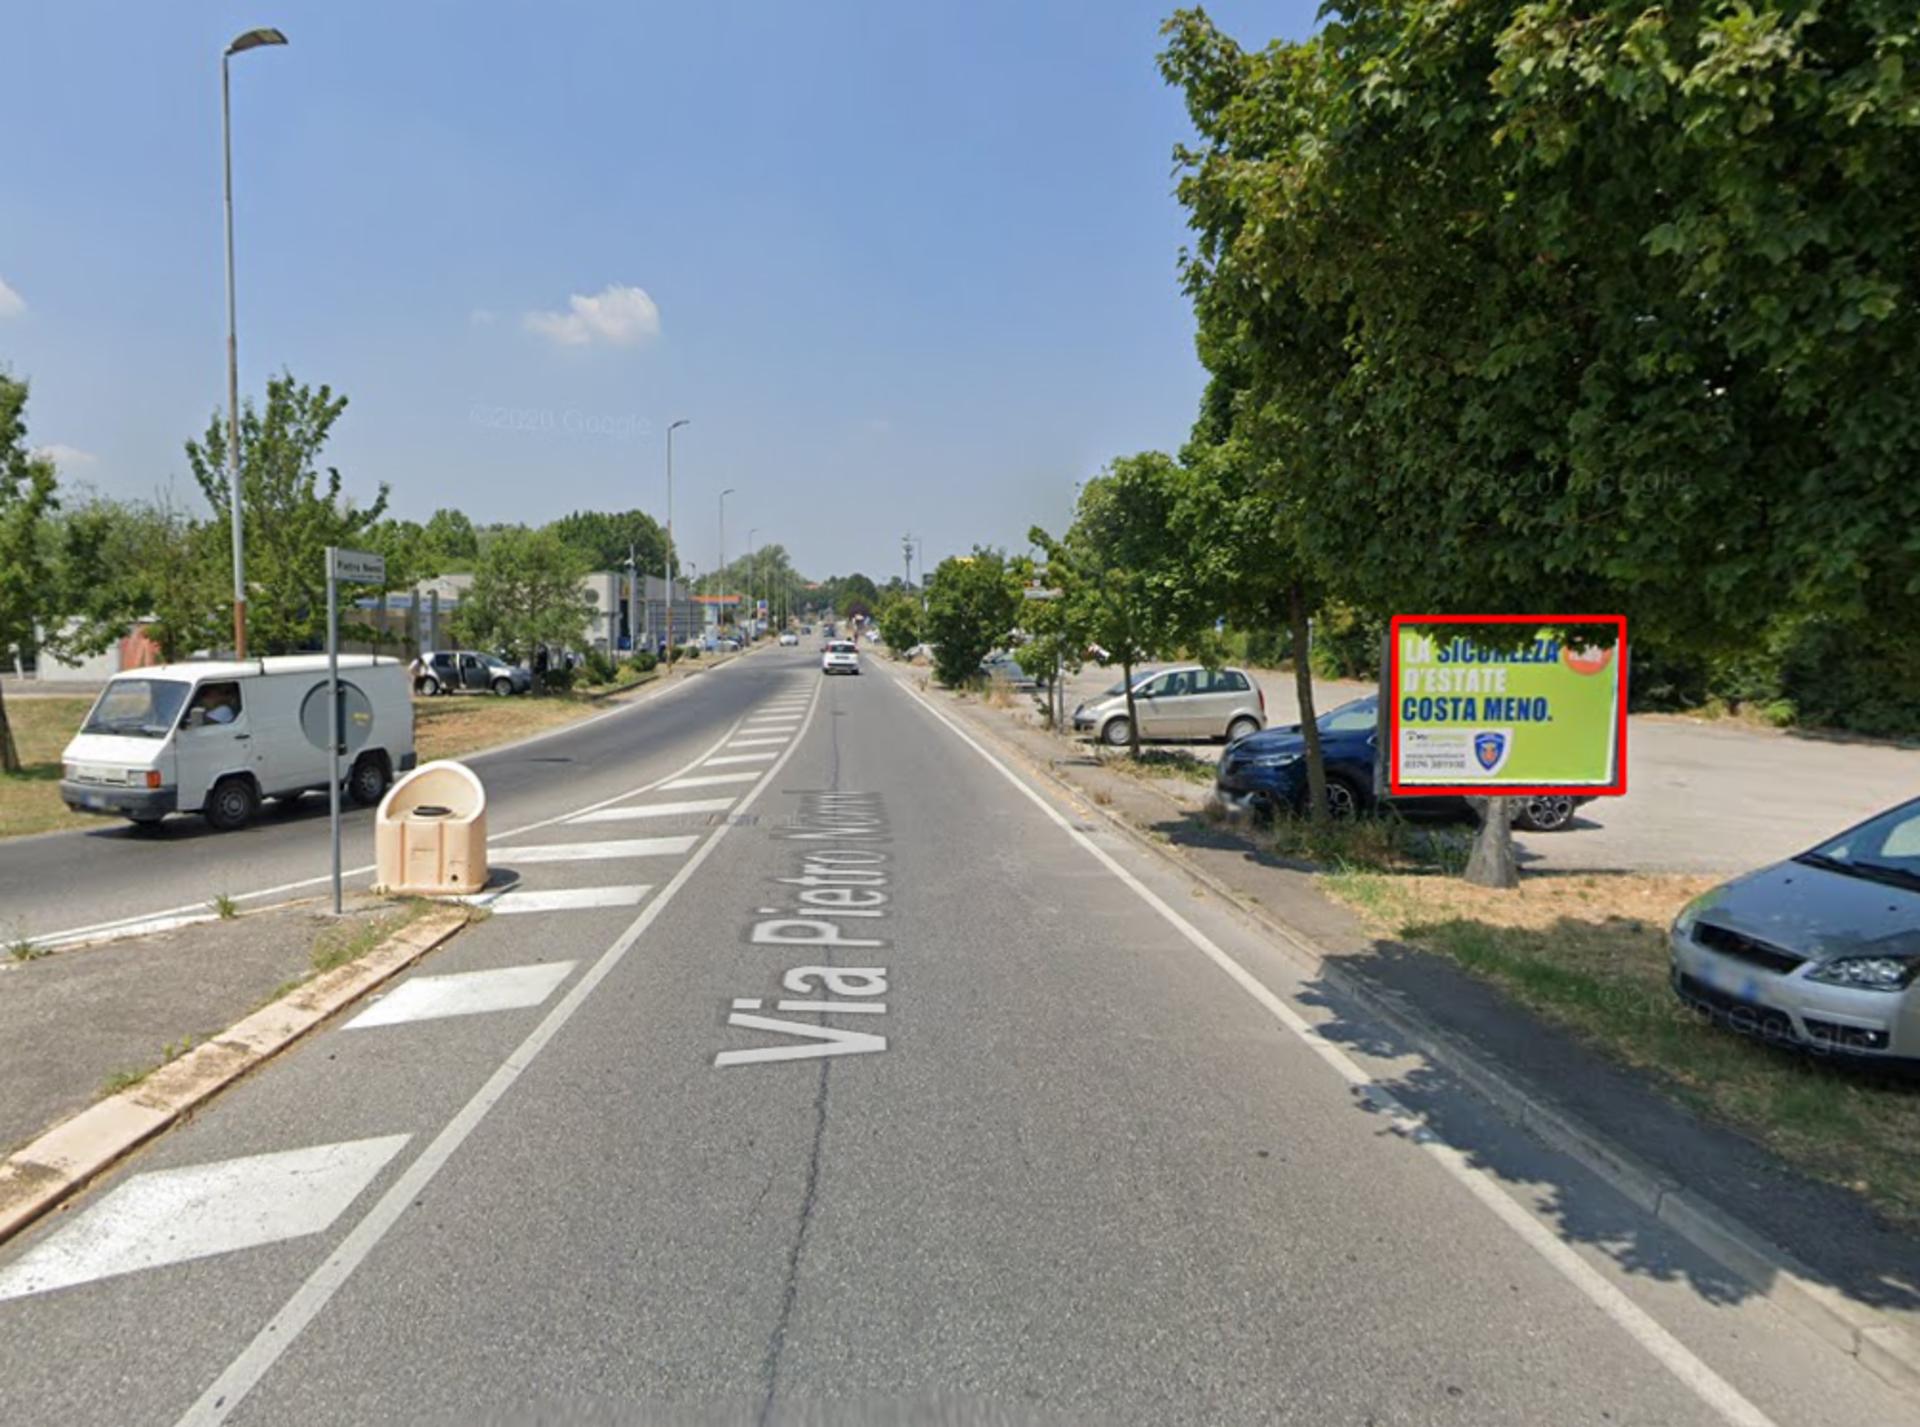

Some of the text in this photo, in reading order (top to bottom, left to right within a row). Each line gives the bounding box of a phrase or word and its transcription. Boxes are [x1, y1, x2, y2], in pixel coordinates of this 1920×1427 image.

[1404, 636, 1431, 664] LA
[1404, 668, 1508, 692] D'ESTATE
[1402, 697, 1553, 722] COSTA MENO.
